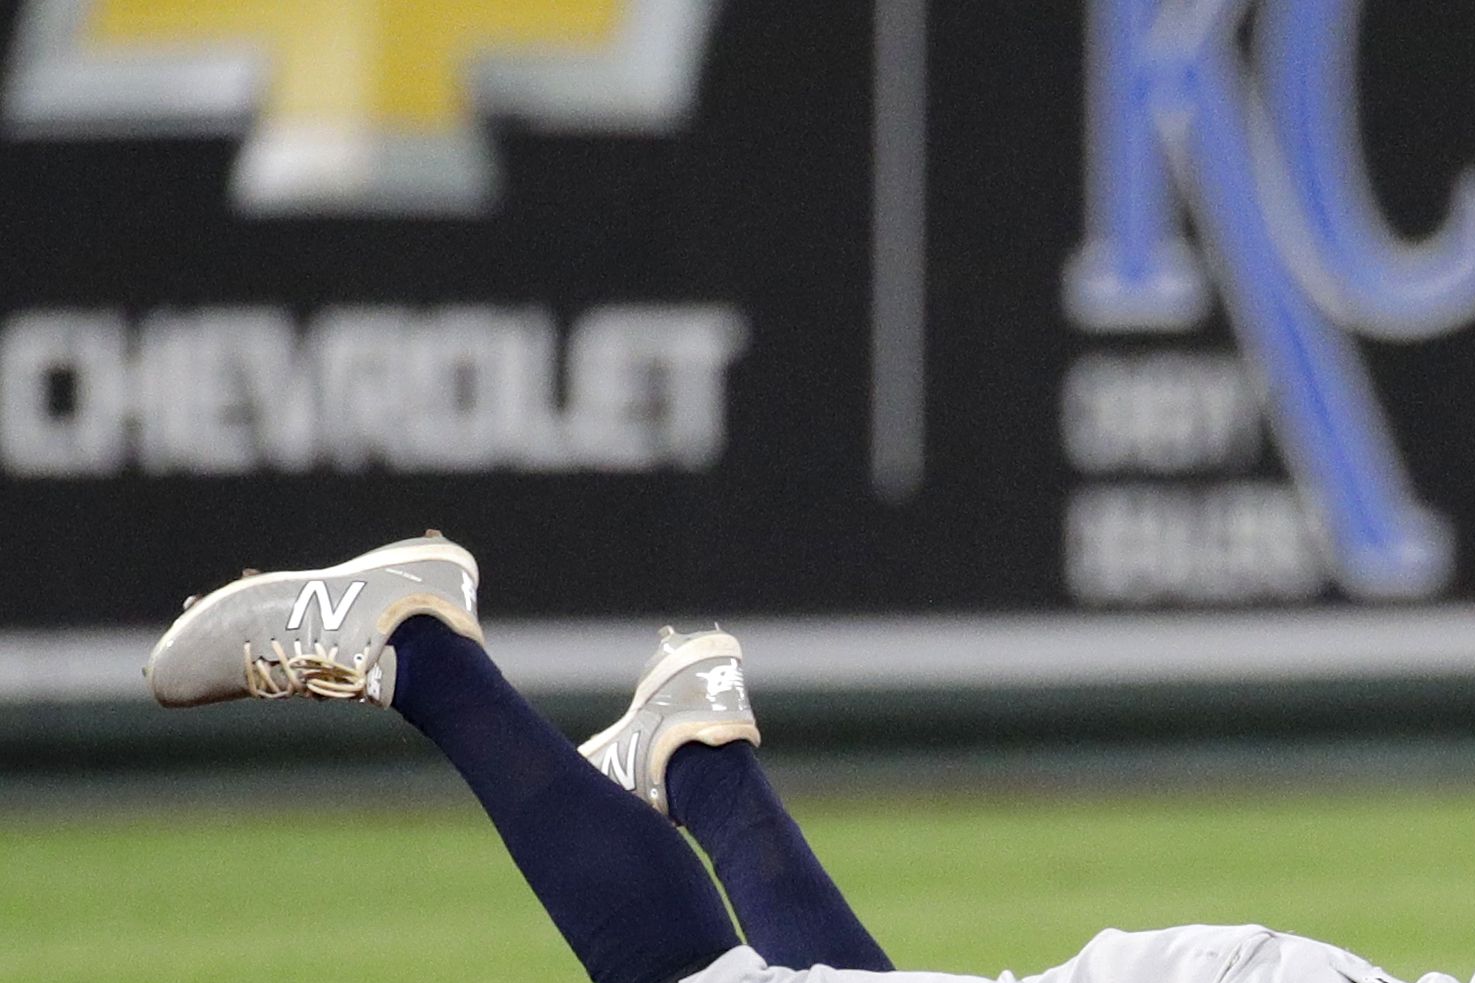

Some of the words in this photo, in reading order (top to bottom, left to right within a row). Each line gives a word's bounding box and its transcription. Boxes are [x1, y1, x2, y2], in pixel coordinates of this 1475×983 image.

[2, 306, 747, 474] CHEVROLET
[285, 579, 368, 631] N
[602, 731, 641, 791] N
